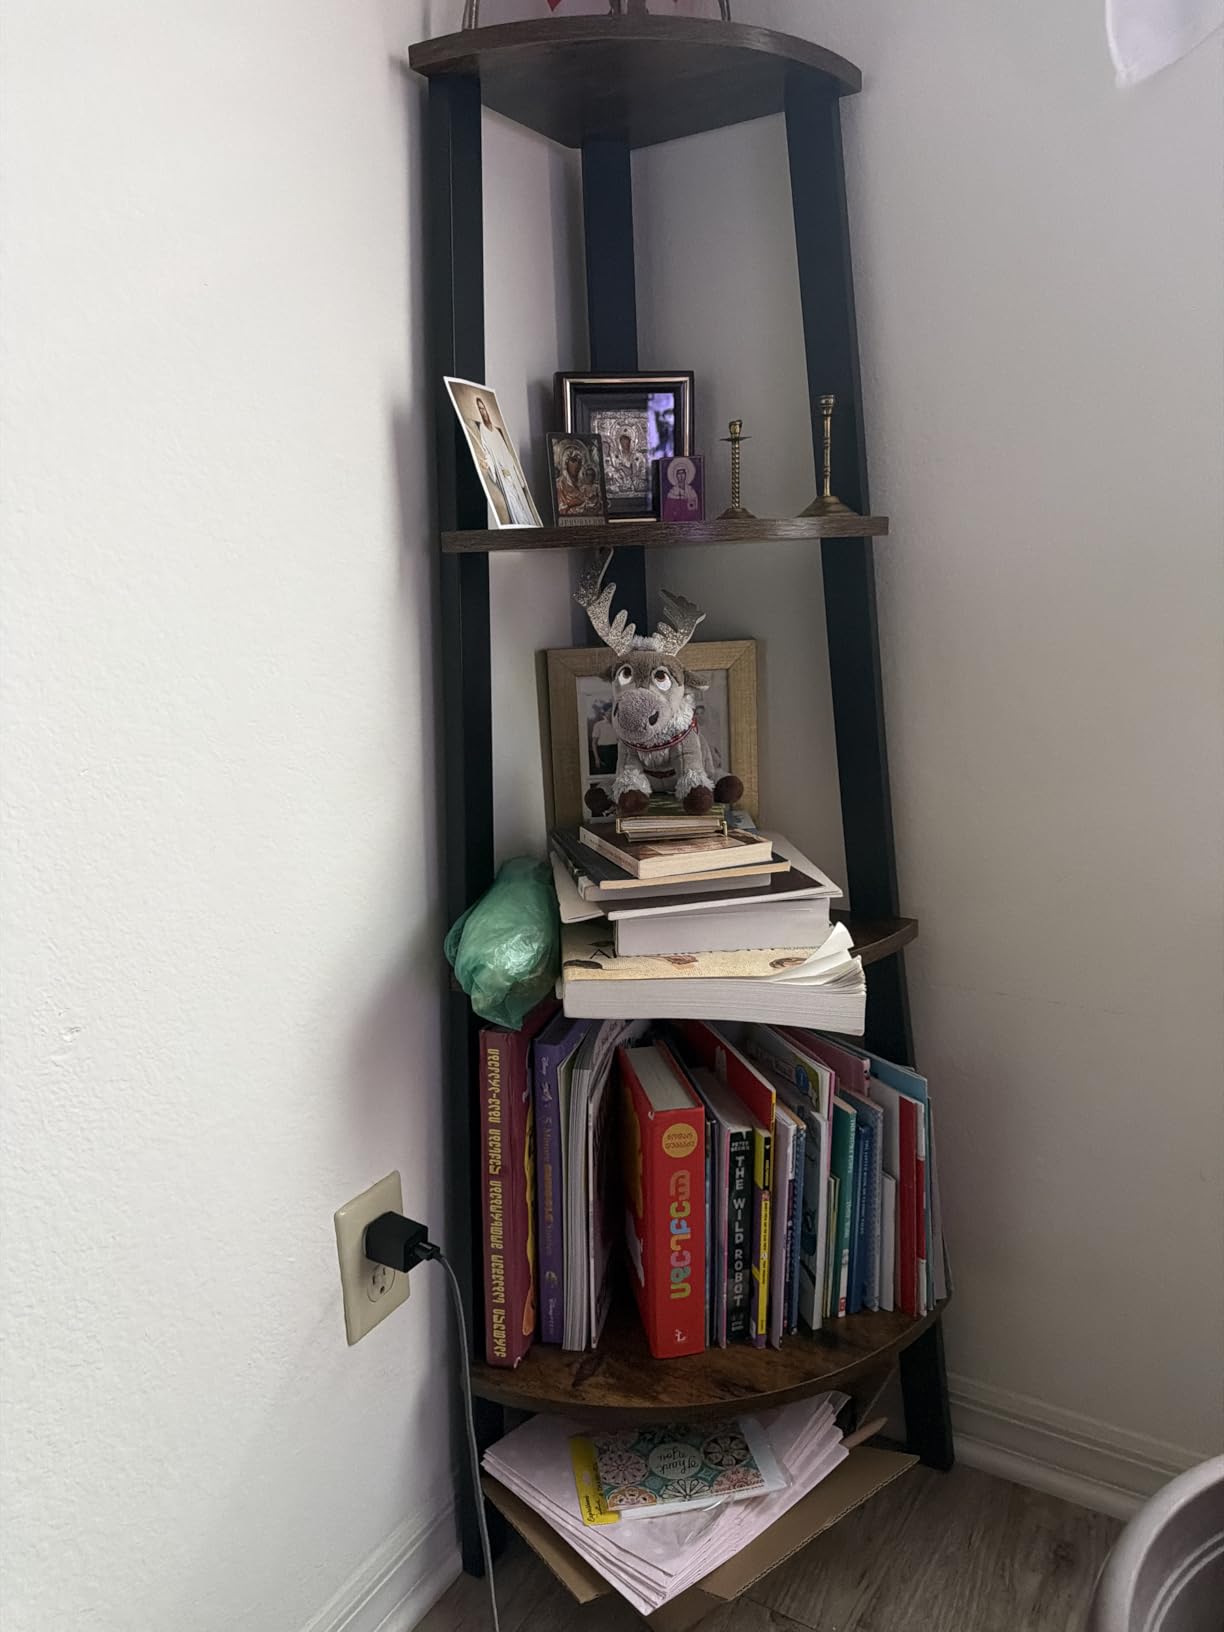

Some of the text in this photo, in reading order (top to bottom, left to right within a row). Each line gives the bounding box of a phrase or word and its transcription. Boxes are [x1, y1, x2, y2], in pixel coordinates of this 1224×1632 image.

[488, 1128, 502, 1175] ლექსები
[735, 1155, 745, 1191] THE
[489, 1180, 504, 1250] მოთხრობები
[670, 1170, 691, 1299] ლექსები
[733, 1197, 746, 1244] WILD
[490, 1254, 506, 1304] საბავშვო
[733, 1248, 745, 1307] ROBOT
[492, 1309, 507, 1358] ქართული
